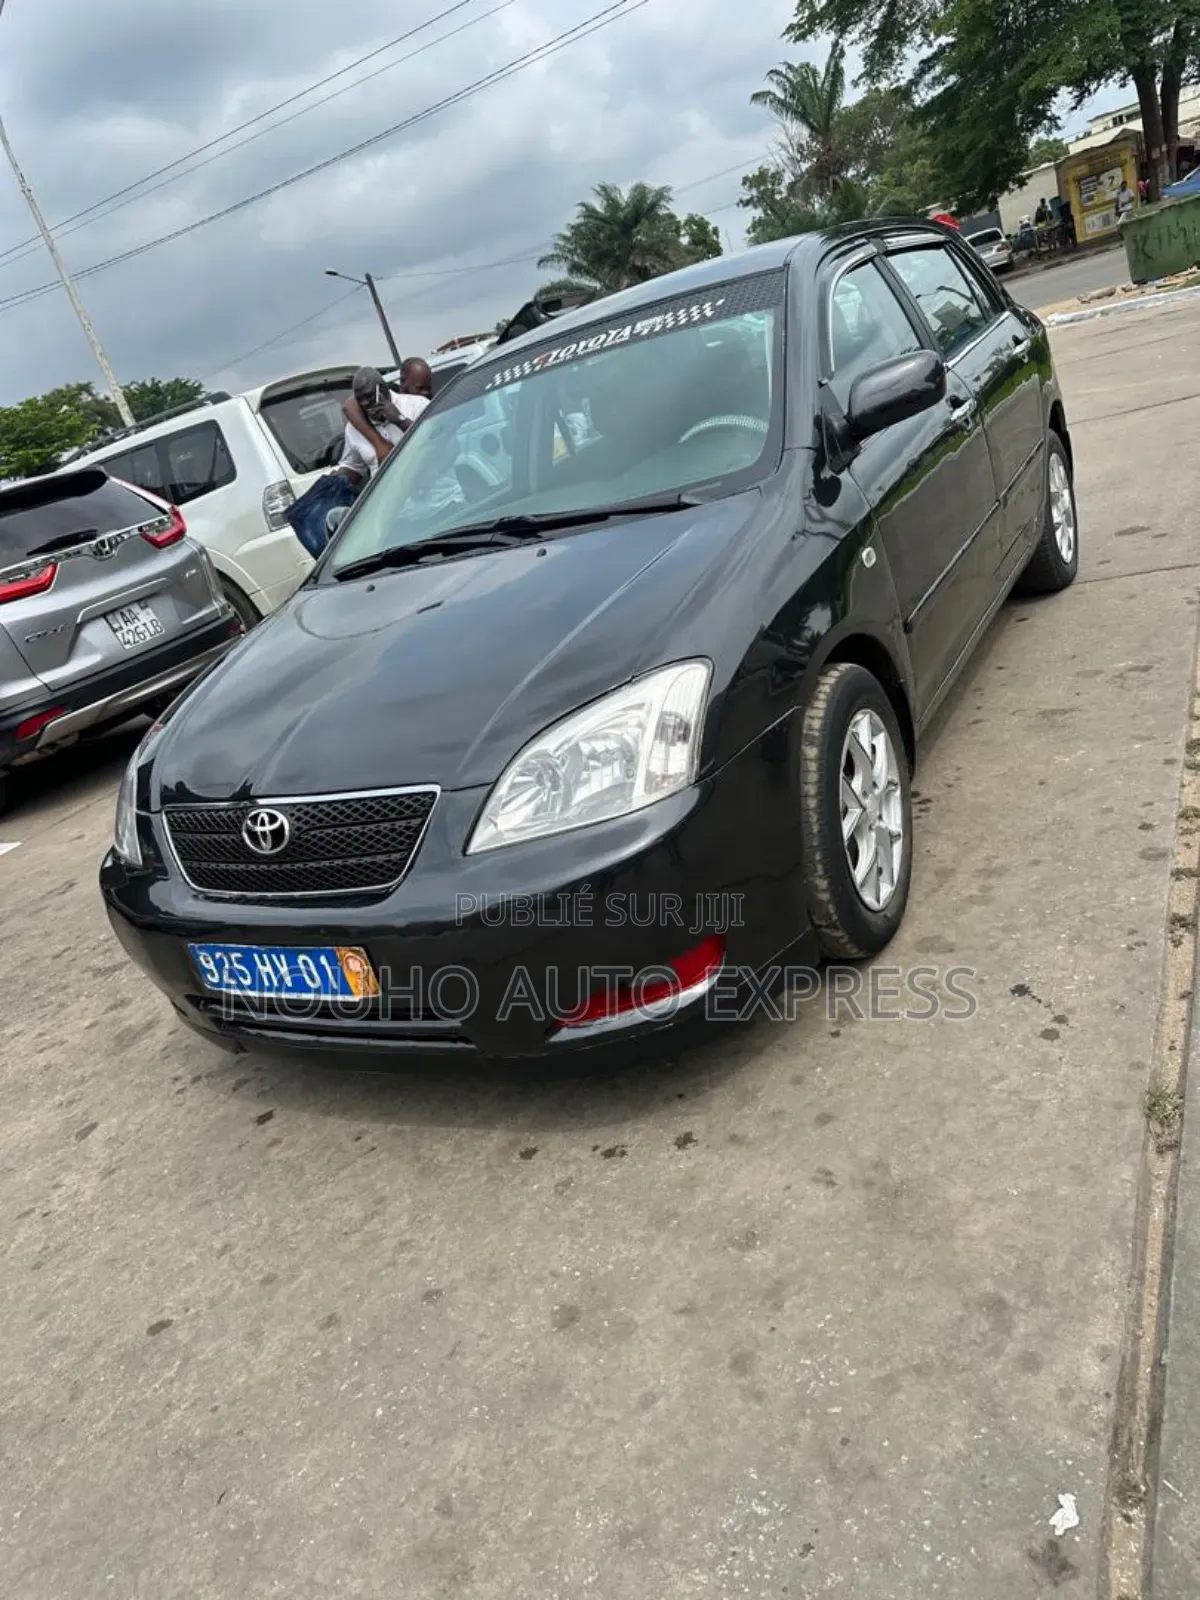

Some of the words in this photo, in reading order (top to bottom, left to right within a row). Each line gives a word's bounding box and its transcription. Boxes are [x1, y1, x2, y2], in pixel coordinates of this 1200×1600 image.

[198, 951, 252, 986] 925
[253, 953, 293, 988] HV
[299, 953, 338, 990] 01
